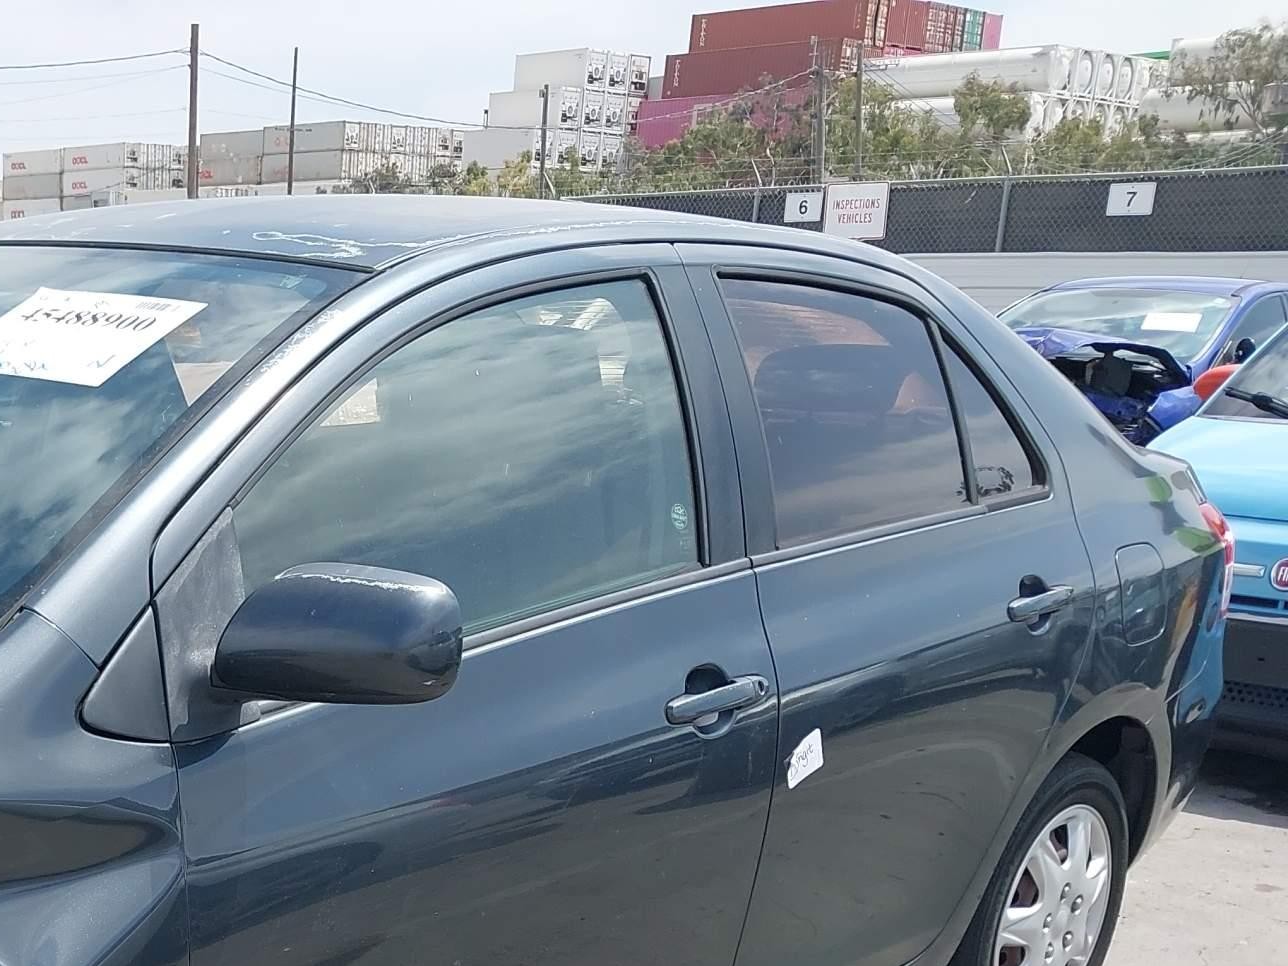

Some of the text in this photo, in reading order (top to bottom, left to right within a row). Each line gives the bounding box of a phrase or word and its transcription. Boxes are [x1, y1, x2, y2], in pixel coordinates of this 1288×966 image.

[832, 198, 880, 210] INSPECTIONS
[1126, 191, 1138, 207] 7
[798, 200, 808, 215] 6
[837, 212, 872, 224] VEHICLES
[21, 308, 156, 331] 45488900
